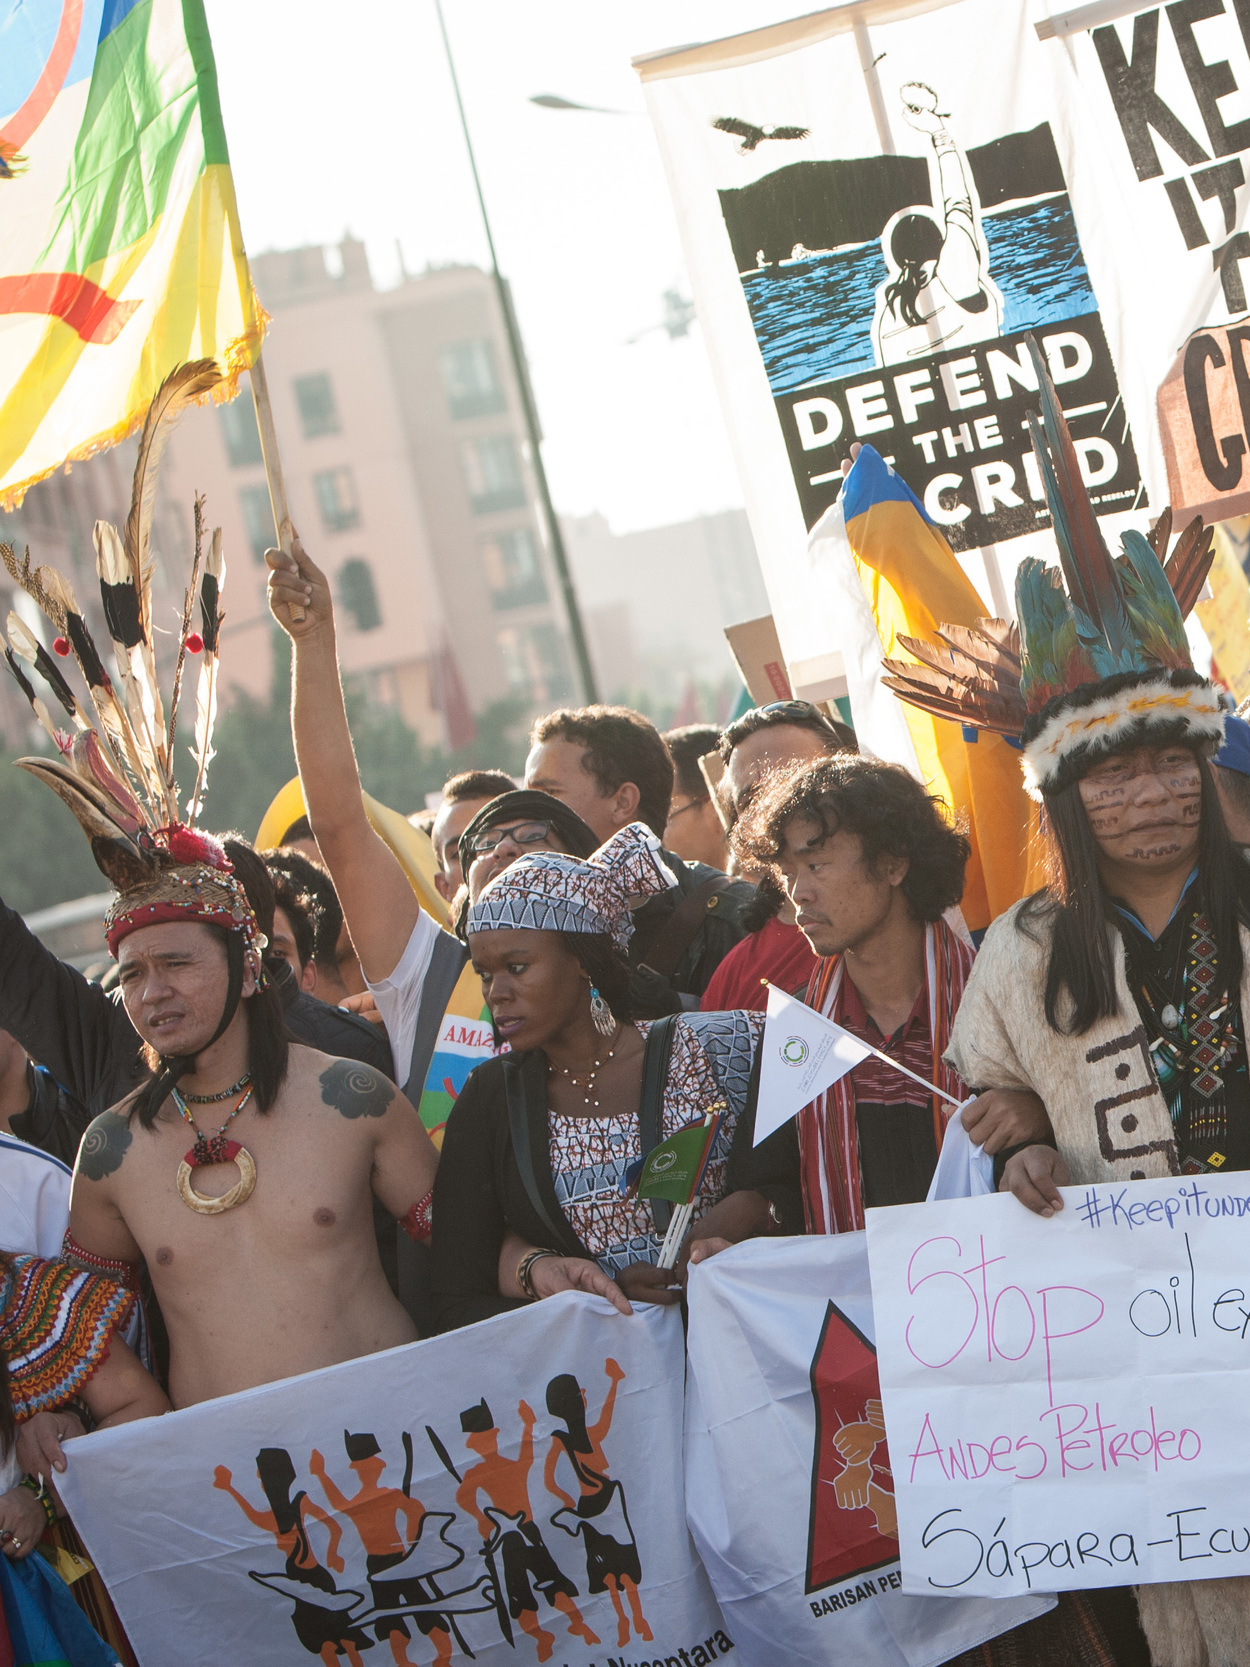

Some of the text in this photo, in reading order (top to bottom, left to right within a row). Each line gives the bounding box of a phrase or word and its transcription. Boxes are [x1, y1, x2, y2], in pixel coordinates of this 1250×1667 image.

[1163, 157, 1245, 251] IT
[793, 332, 1093, 451] DEFEND
[913, 415, 1003, 465] THE
[905, 1234, 1104, 1407] Stop
[1129, 1232, 1197, 1337] oil
[809, 1580, 878, 1618] BARISAN
